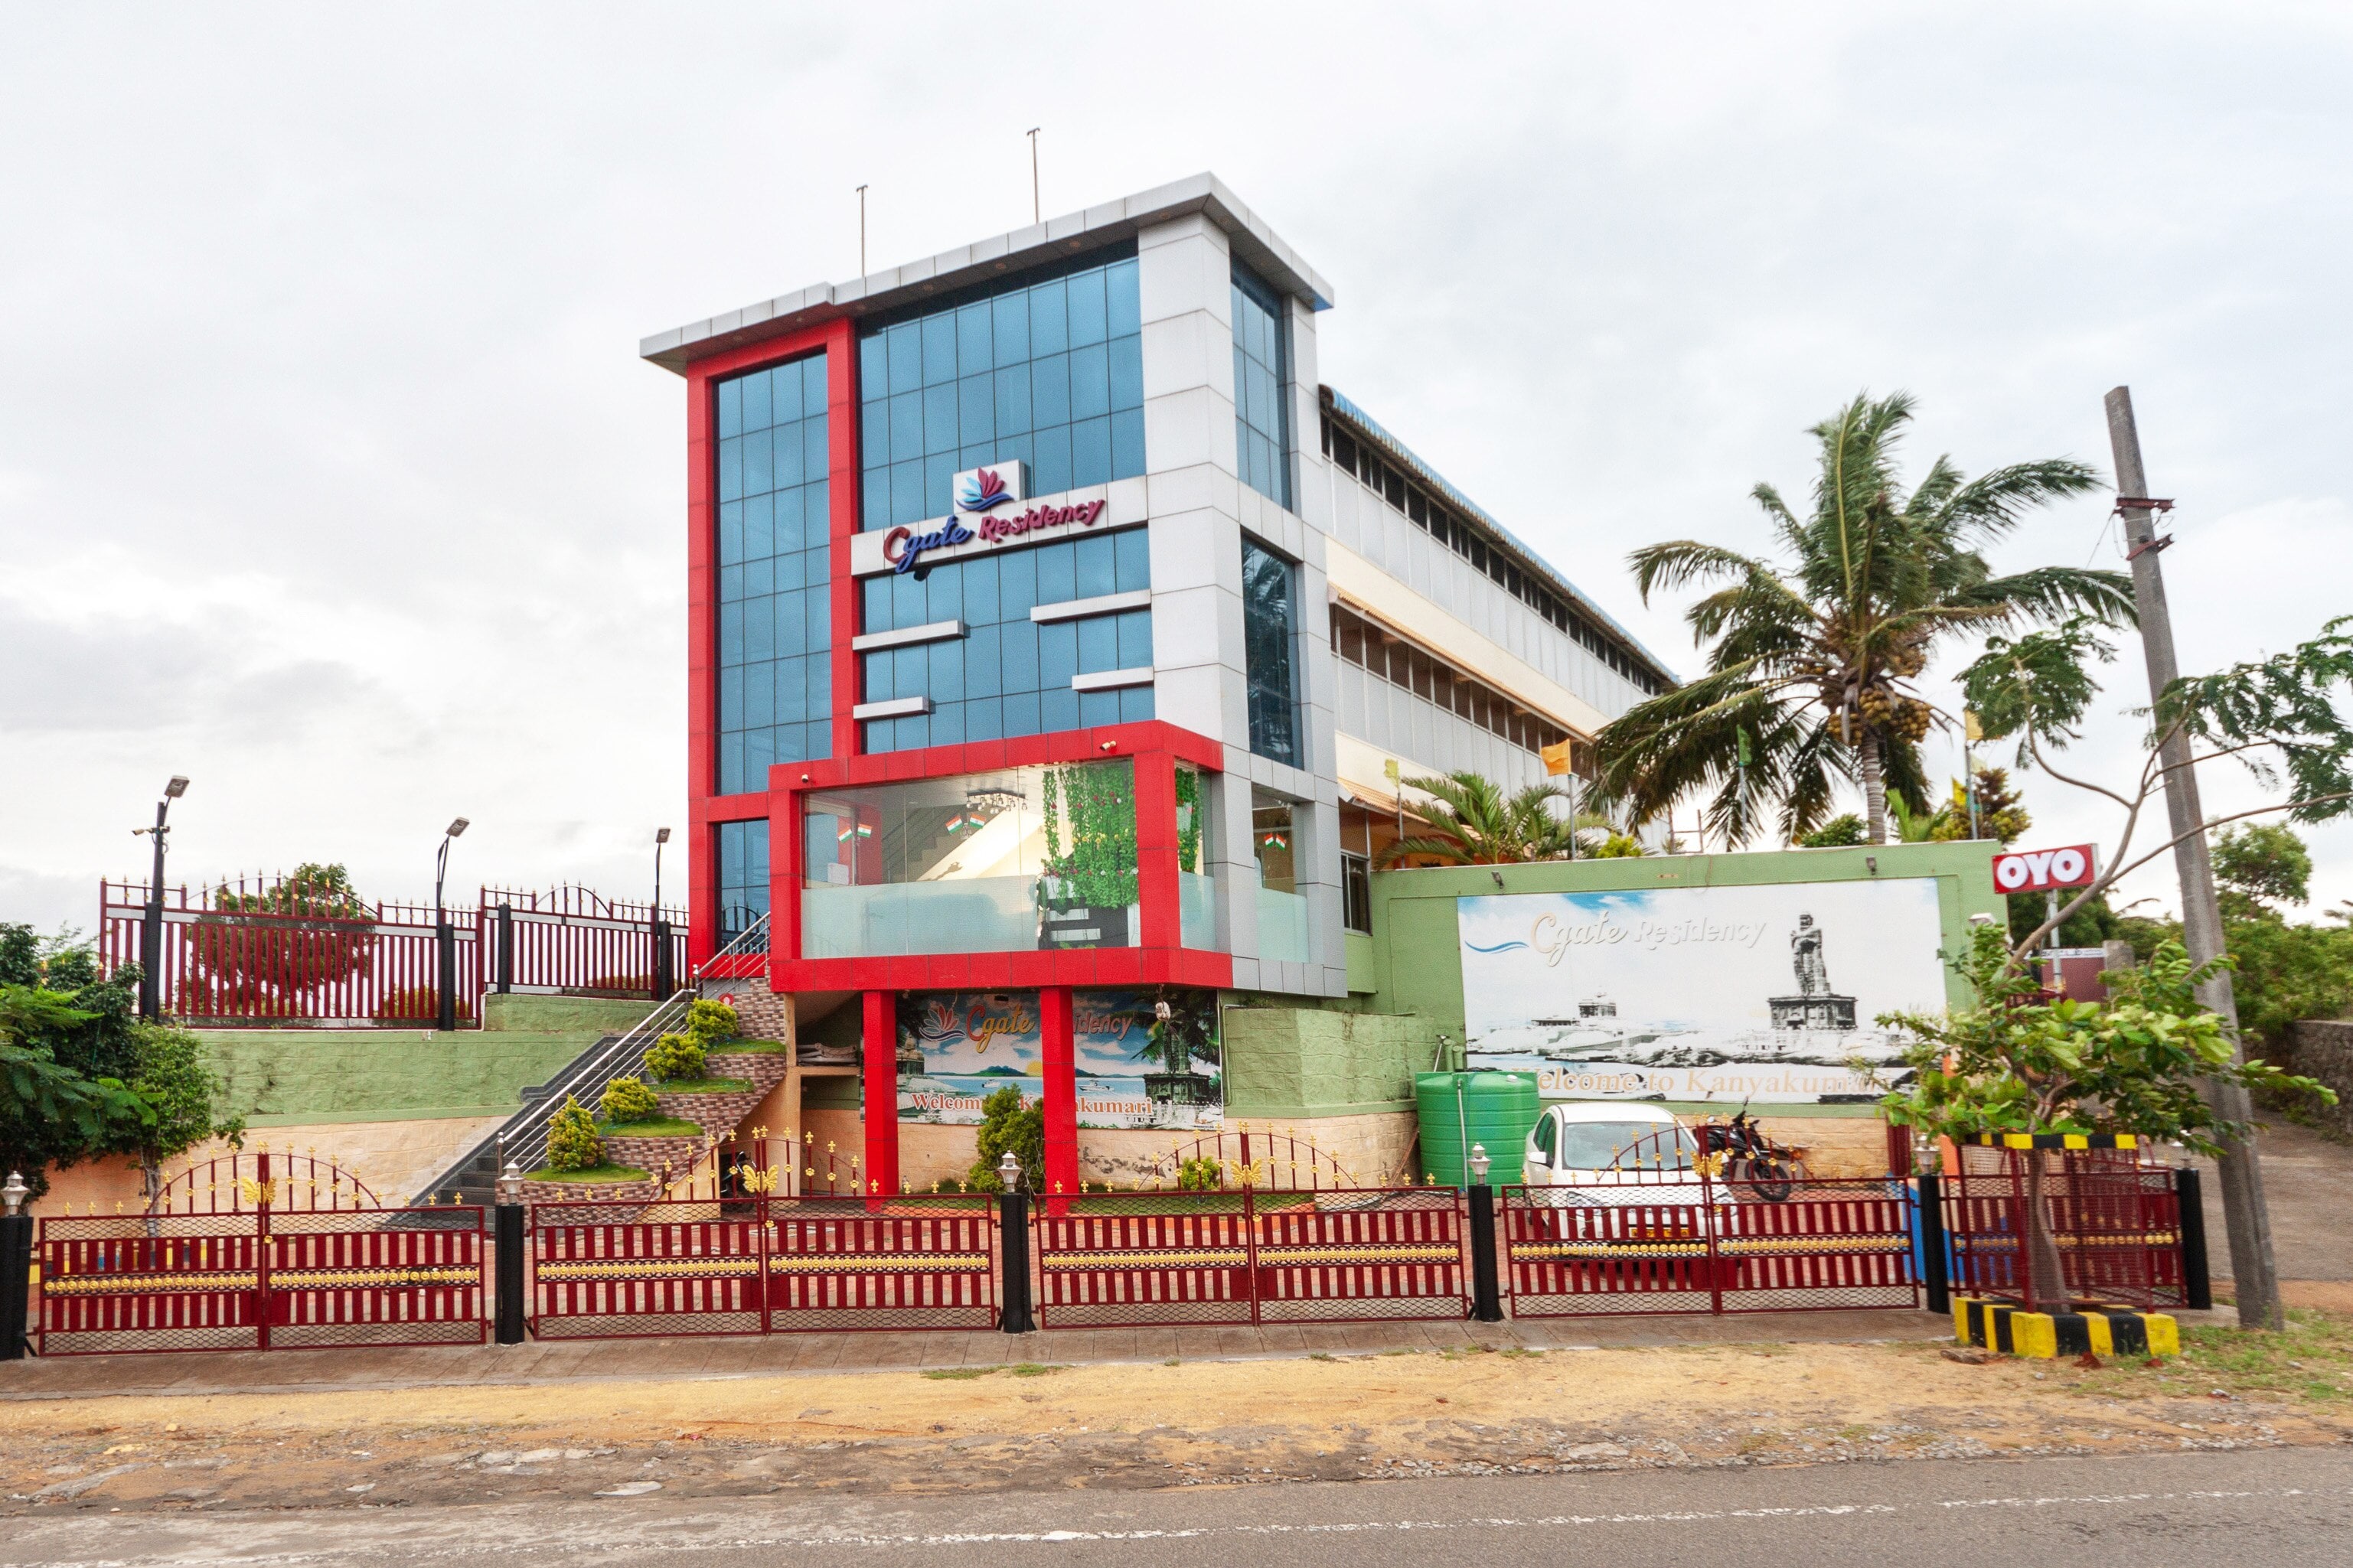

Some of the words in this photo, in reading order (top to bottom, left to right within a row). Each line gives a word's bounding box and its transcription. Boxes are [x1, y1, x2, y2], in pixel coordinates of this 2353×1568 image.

[883, 515, 974, 574] Cgate
[978, 499, 1106, 543] Residency
[1997, 849, 2086, 888] OYO
[1531, 911, 1628, 967] Cgate
[1633, 918, 1766, 950] Residency
[966, 1004, 1035, 1053] Cgate
[1039, 1011, 1134, 1041] idency
[1511, 1066, 1639, 1090] elcome
[1648, 1072, 1675, 1091] to
[911, 1092, 983, 1110] Welcom
